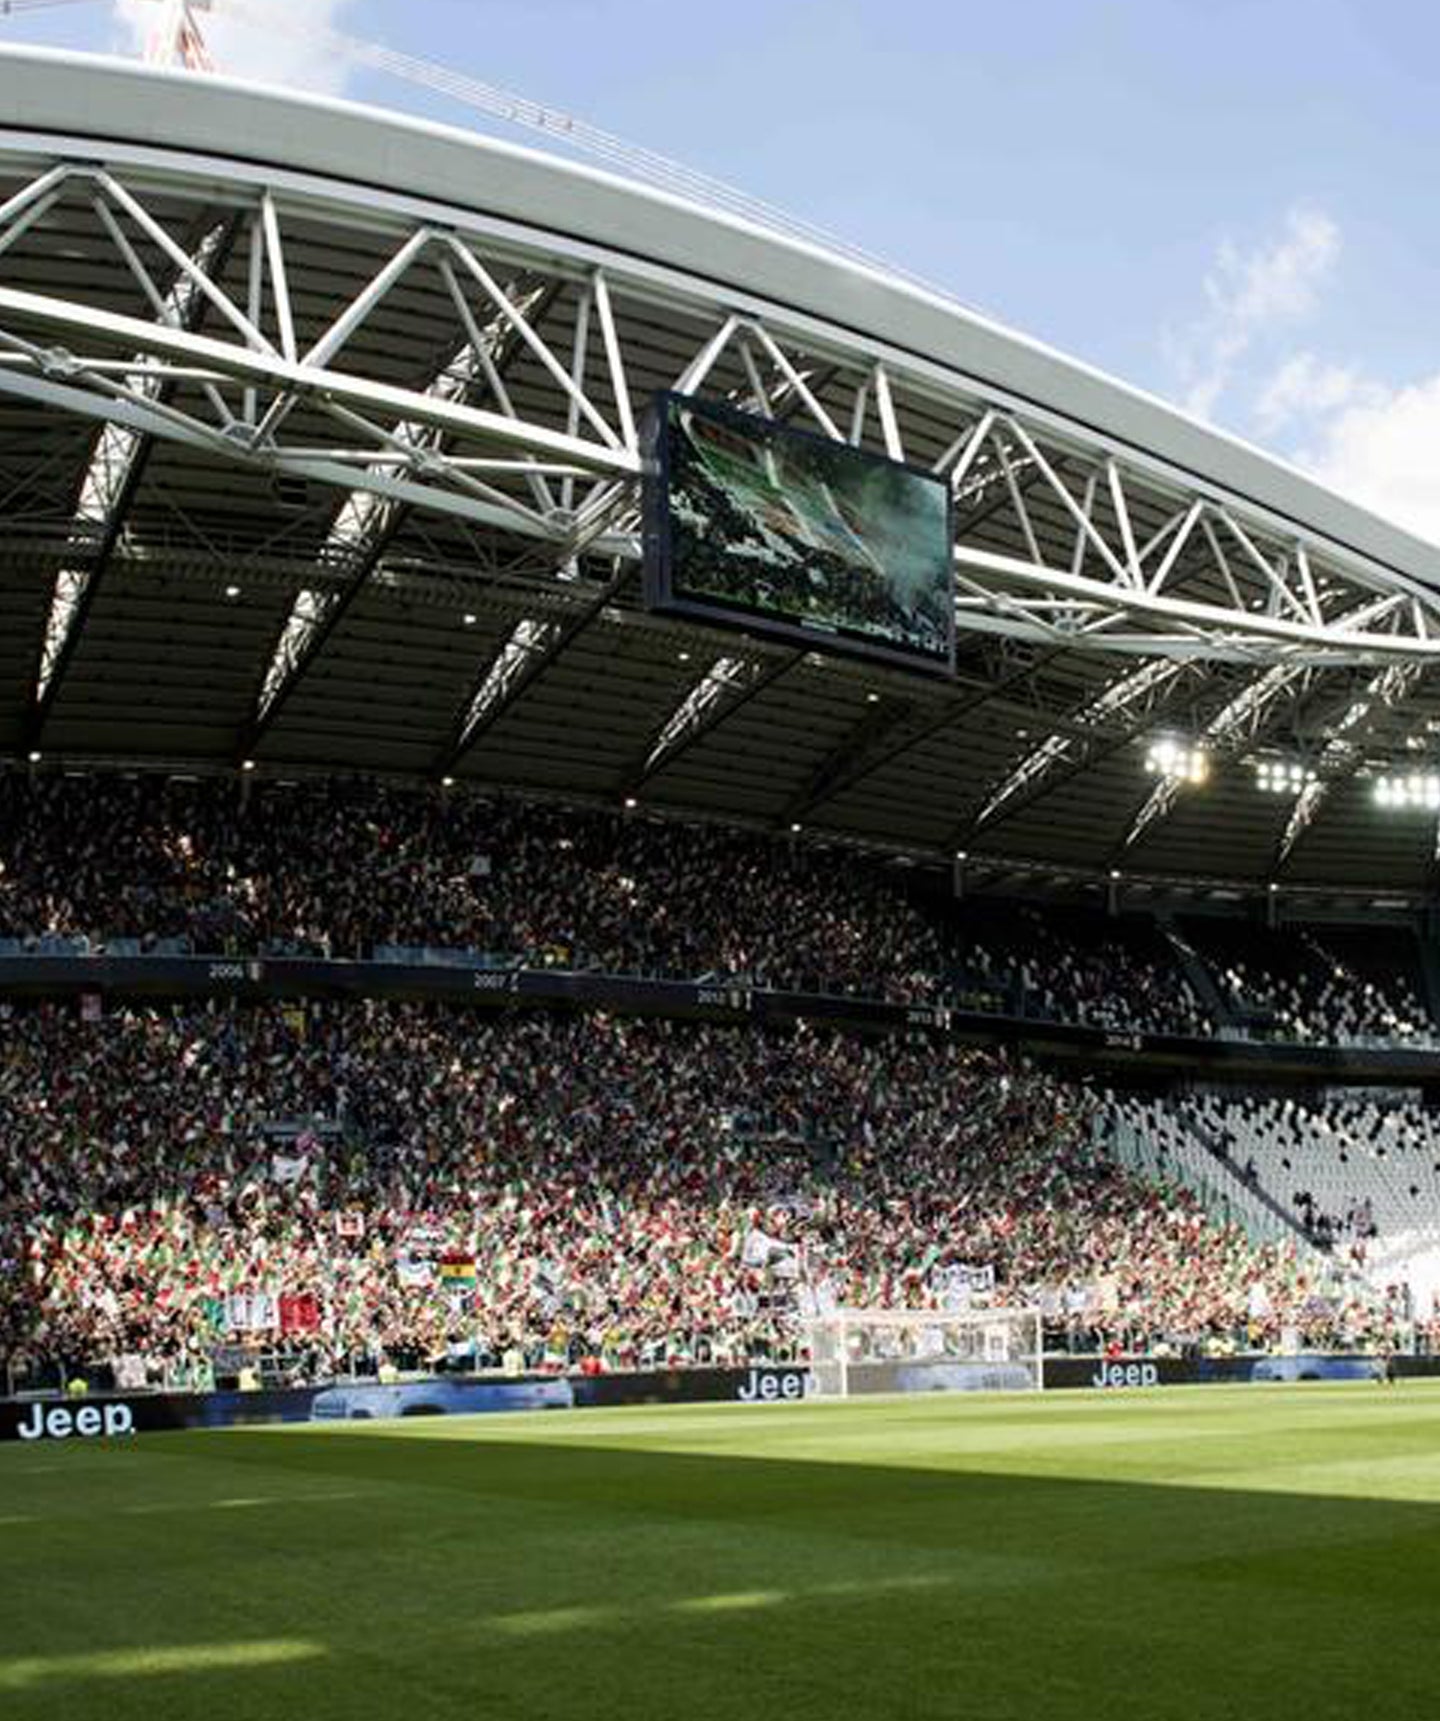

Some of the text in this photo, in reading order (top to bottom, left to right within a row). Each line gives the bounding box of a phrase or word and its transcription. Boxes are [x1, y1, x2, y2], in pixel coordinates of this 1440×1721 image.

[738, 1368, 820, 1400] Jeep
[1093, 1361, 1159, 1387] Jeep
[17, 1402, 136, 1439] Jeep
